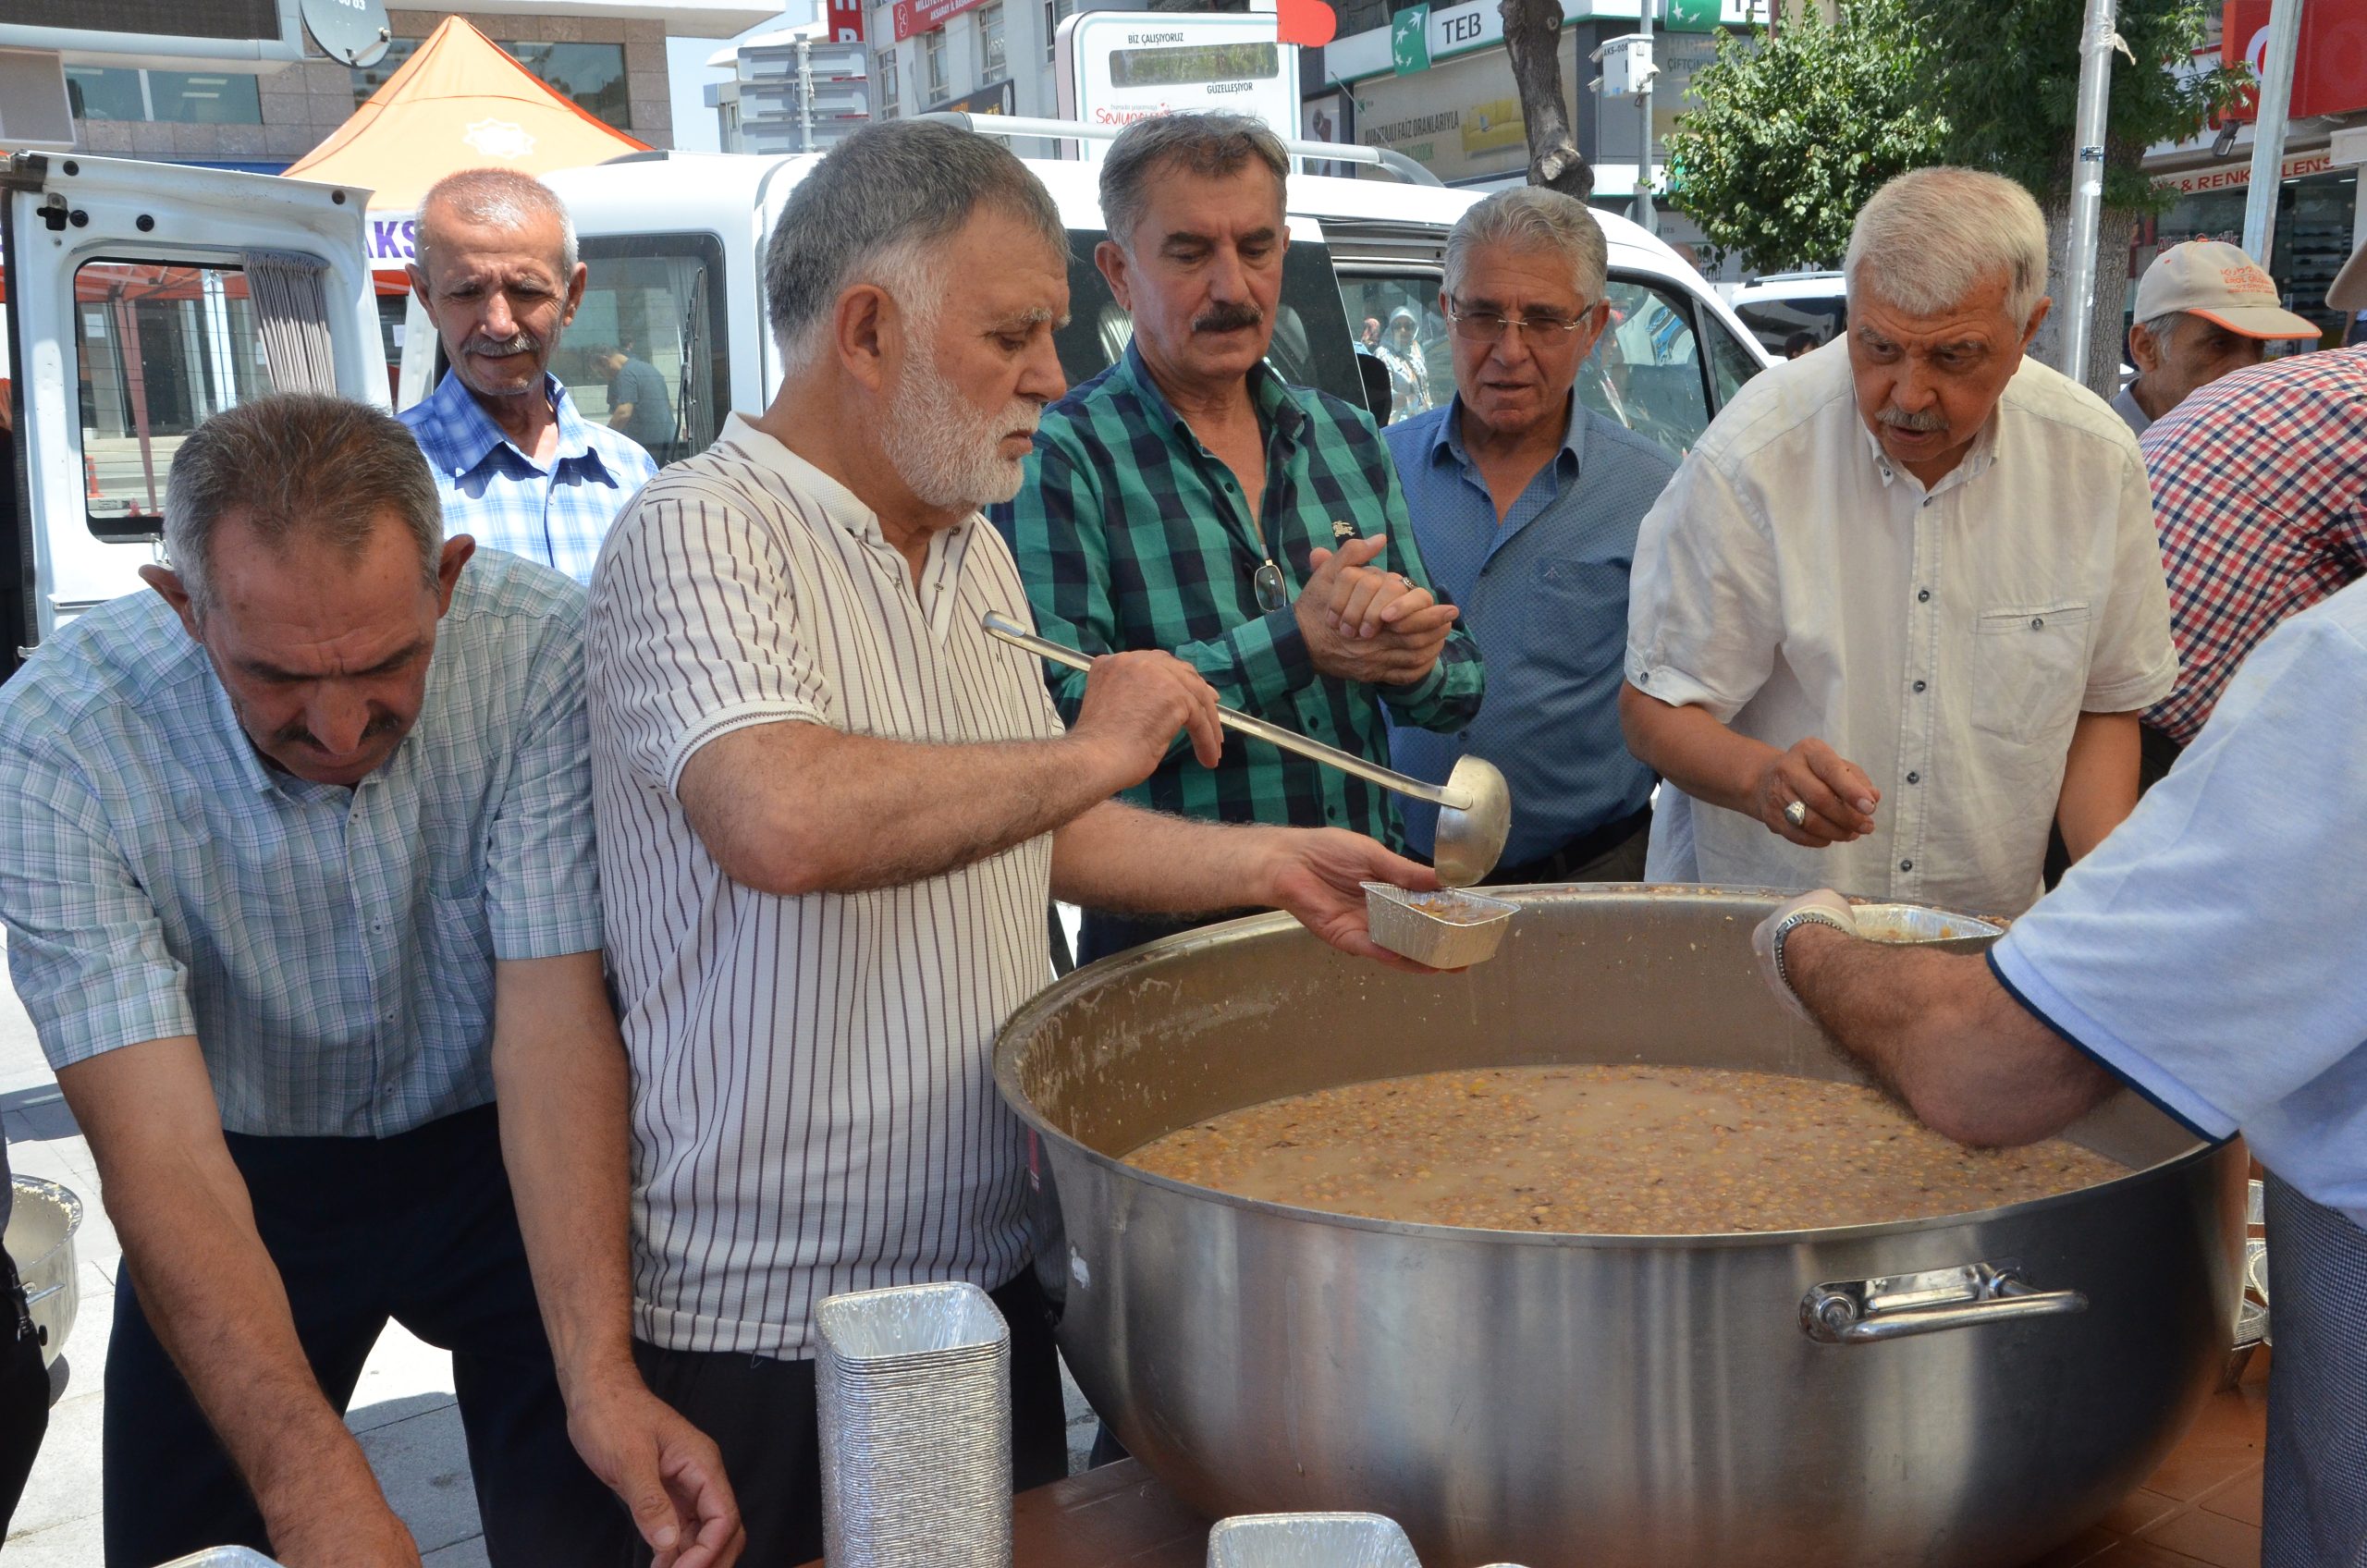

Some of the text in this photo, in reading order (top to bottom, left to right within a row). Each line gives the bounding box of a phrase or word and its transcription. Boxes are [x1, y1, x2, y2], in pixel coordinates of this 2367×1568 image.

[1128, 31, 1184, 46] BİZ ÇALIŞIYORUZ
[1442, 12, 1481, 44] TEB
[1207, 80, 1254, 94] GÜZELLEŞİYOR
[1397, 116, 1413, 141] FAİZ
[1413, 110, 1459, 138] ORANLARIYLA
[2281, 156, 2335, 178] LENS
